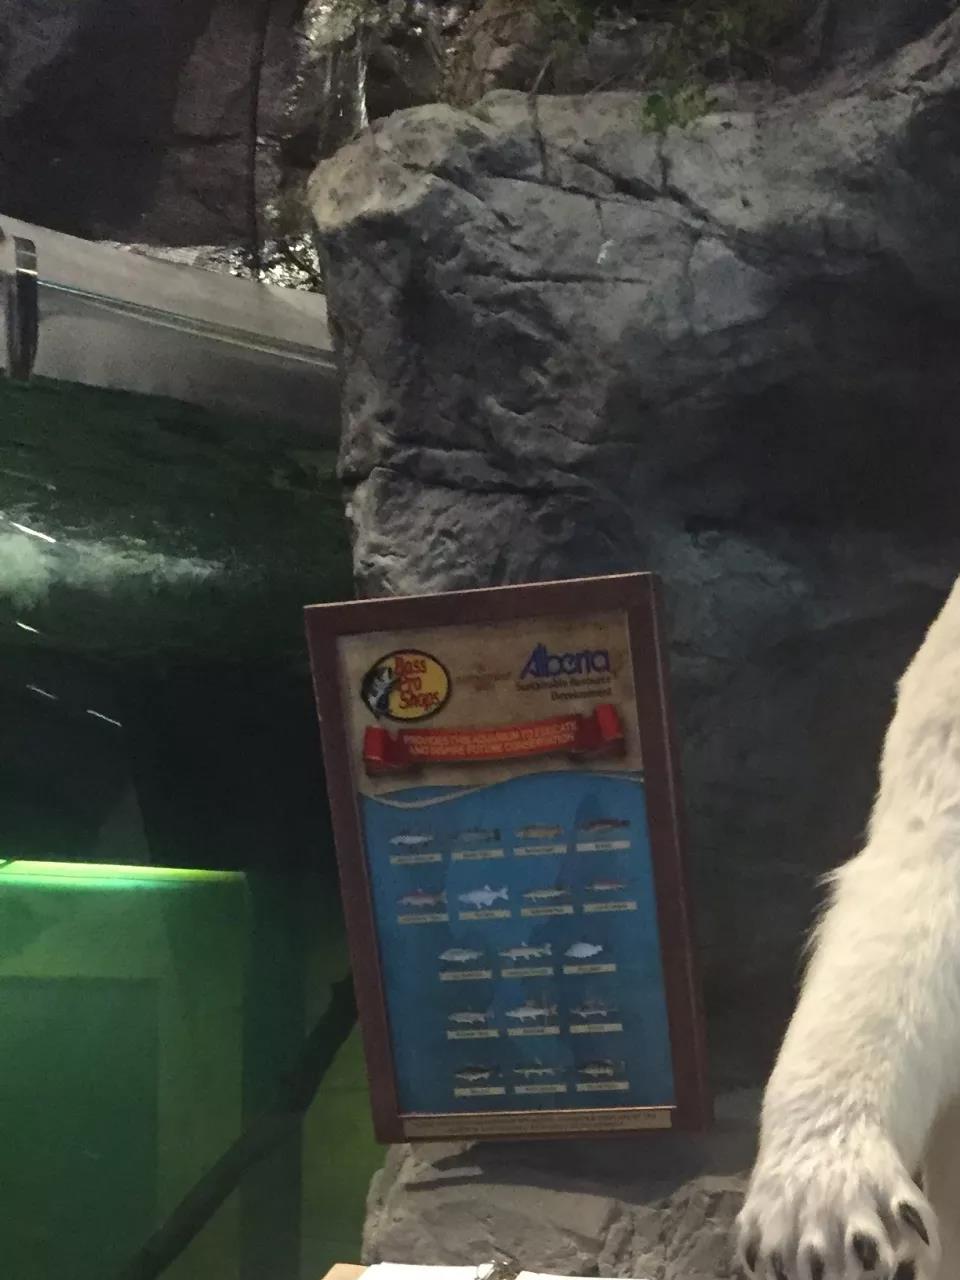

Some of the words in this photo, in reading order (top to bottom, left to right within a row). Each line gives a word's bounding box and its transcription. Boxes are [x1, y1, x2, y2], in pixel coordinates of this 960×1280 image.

[395, 655, 427, 676] Bass
[397, 676, 422, 693] Pro
[400, 690, 440, 711] Shops
